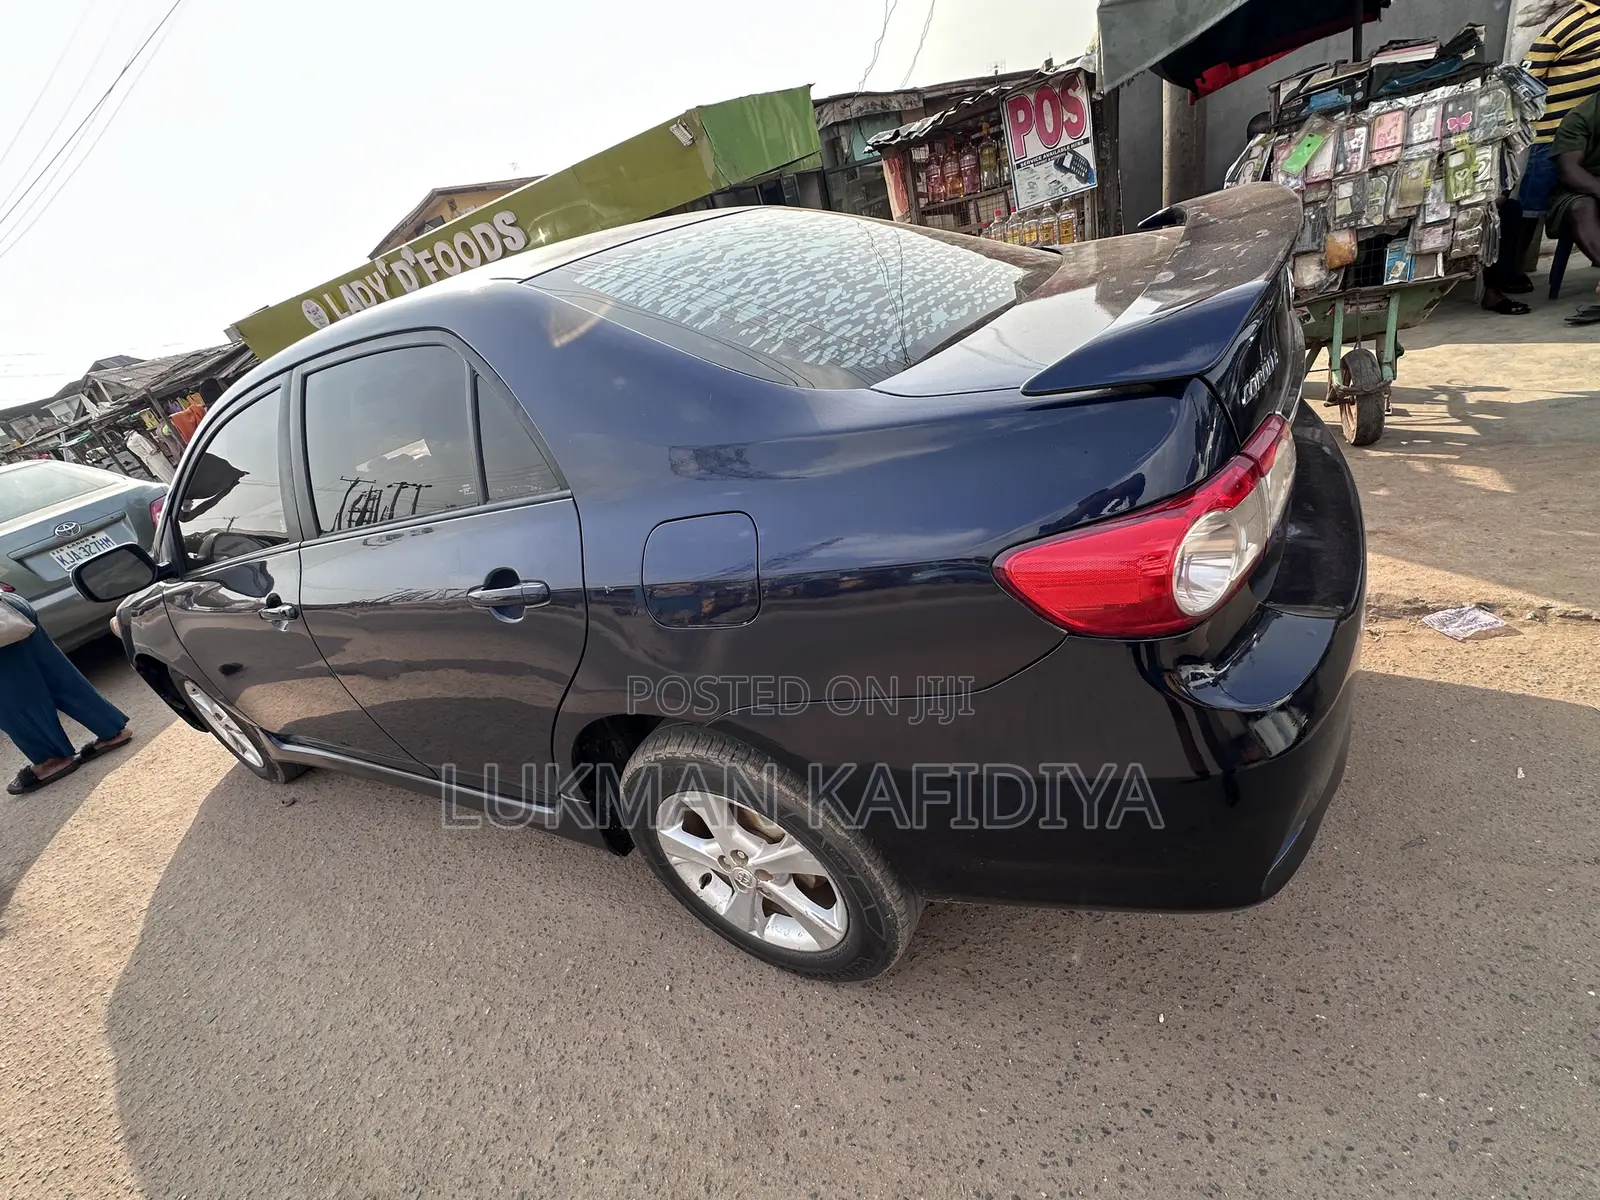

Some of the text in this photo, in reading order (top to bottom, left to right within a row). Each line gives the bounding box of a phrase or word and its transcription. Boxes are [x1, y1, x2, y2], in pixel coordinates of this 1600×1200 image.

[1005, 72, 1087, 162] POS
[1019, 155, 1043, 168] SERVICE
[1043, 144, 1071, 157] AVAILABLE
[415, 211, 527, 284] FOODS
